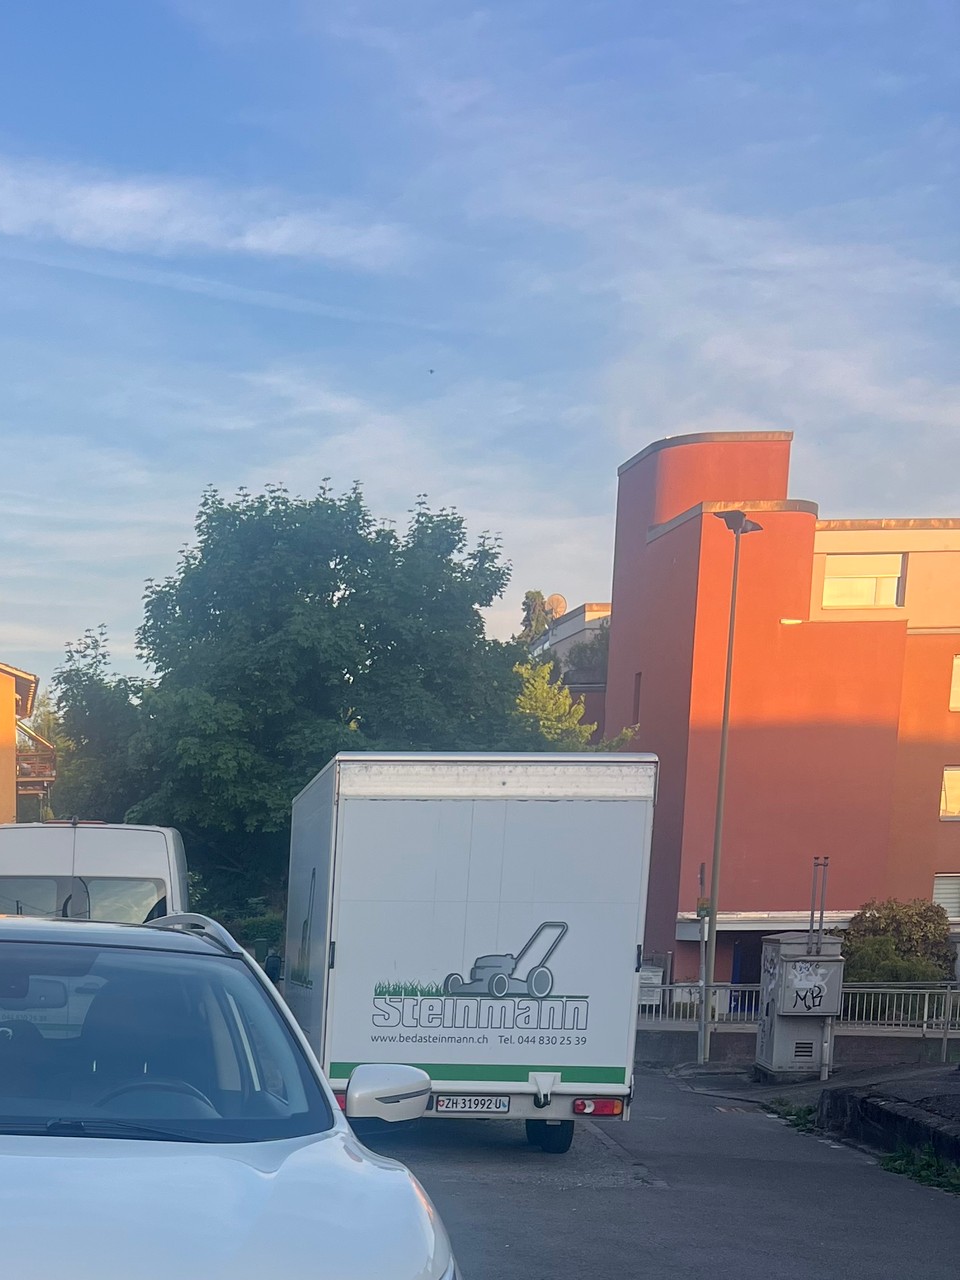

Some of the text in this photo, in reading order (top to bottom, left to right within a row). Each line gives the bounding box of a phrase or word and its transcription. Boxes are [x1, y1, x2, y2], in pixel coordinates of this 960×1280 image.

[372, 997, 589, 1030] Steinmann
[371, 1033, 587, 1045] www.bedasteinmann.ch Tel. 044 830 25 39
